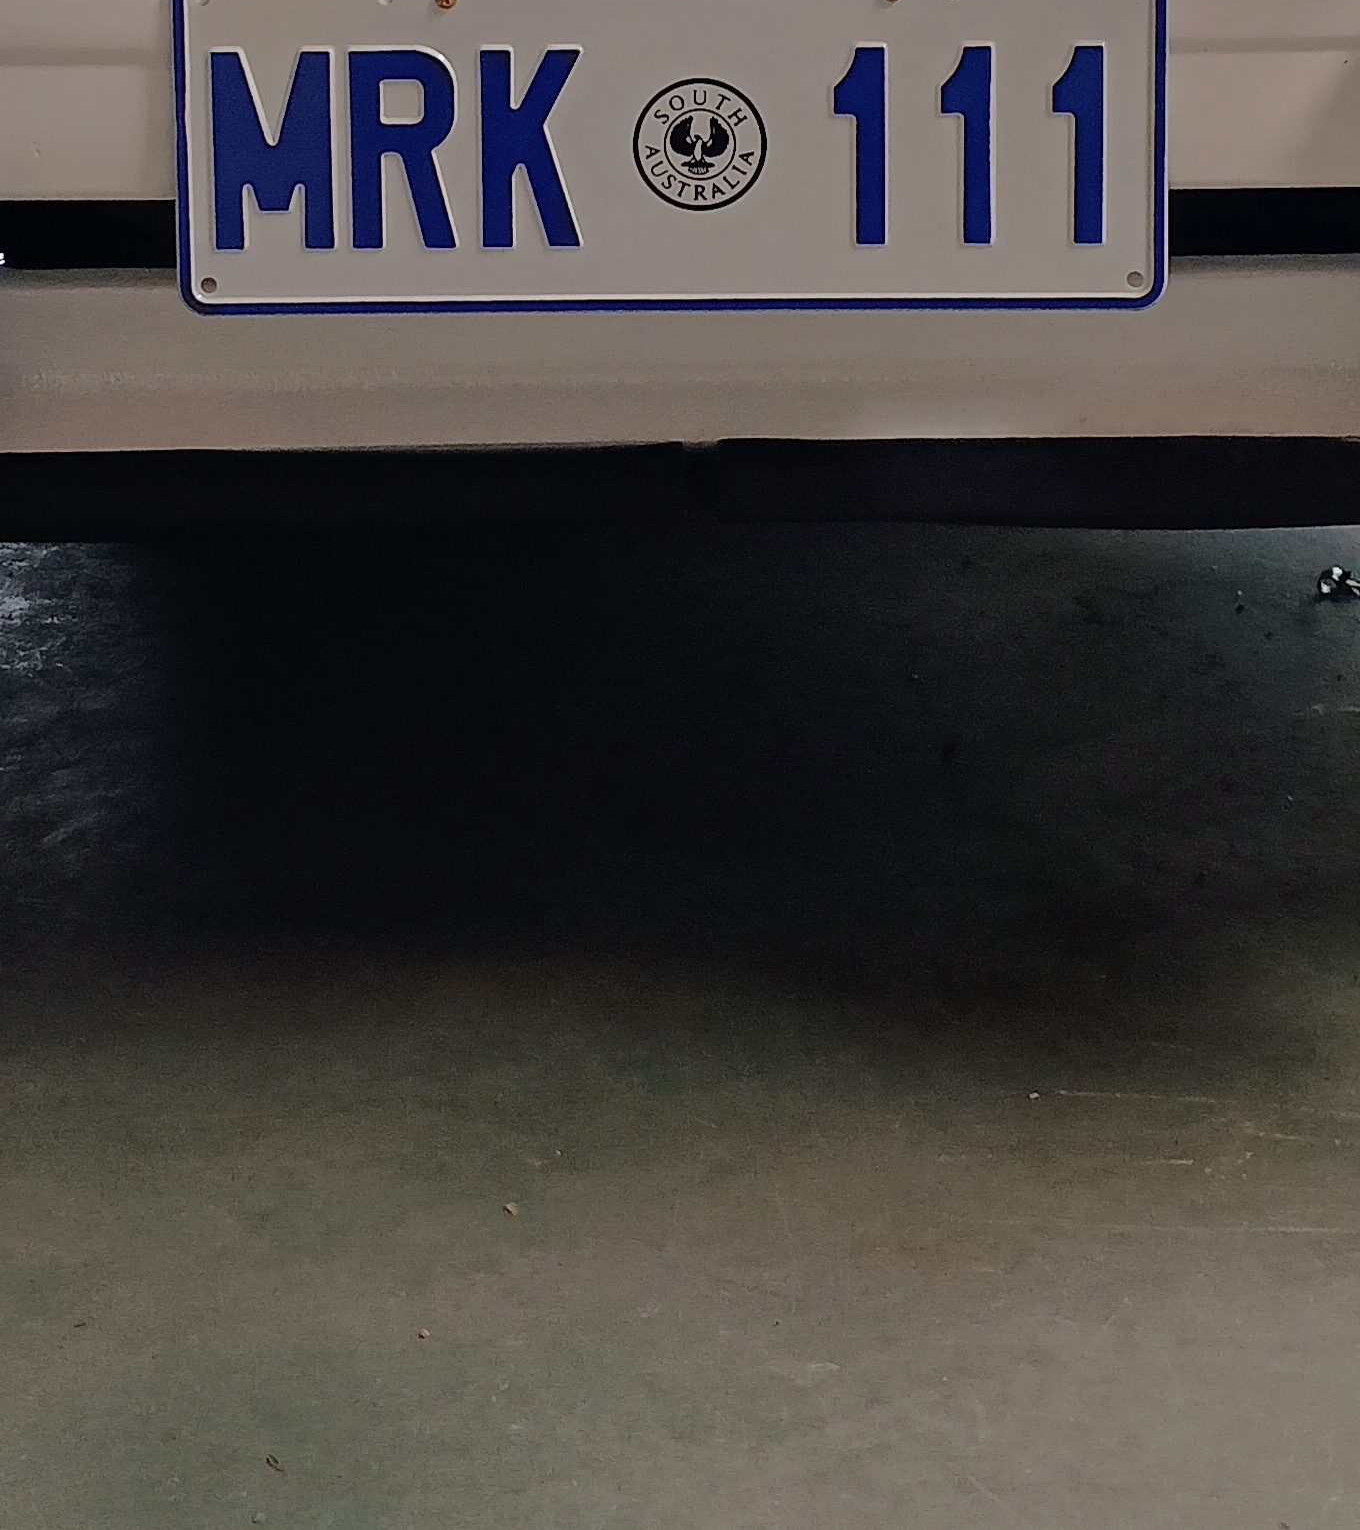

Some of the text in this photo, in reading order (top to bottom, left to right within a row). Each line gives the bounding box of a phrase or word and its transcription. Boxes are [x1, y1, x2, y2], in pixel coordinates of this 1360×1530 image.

[654, 89, 748, 127] SOUTH
[208, 40, 1107, 250] MRK 111
[644, 144, 755, 201] AUSTRALIA
